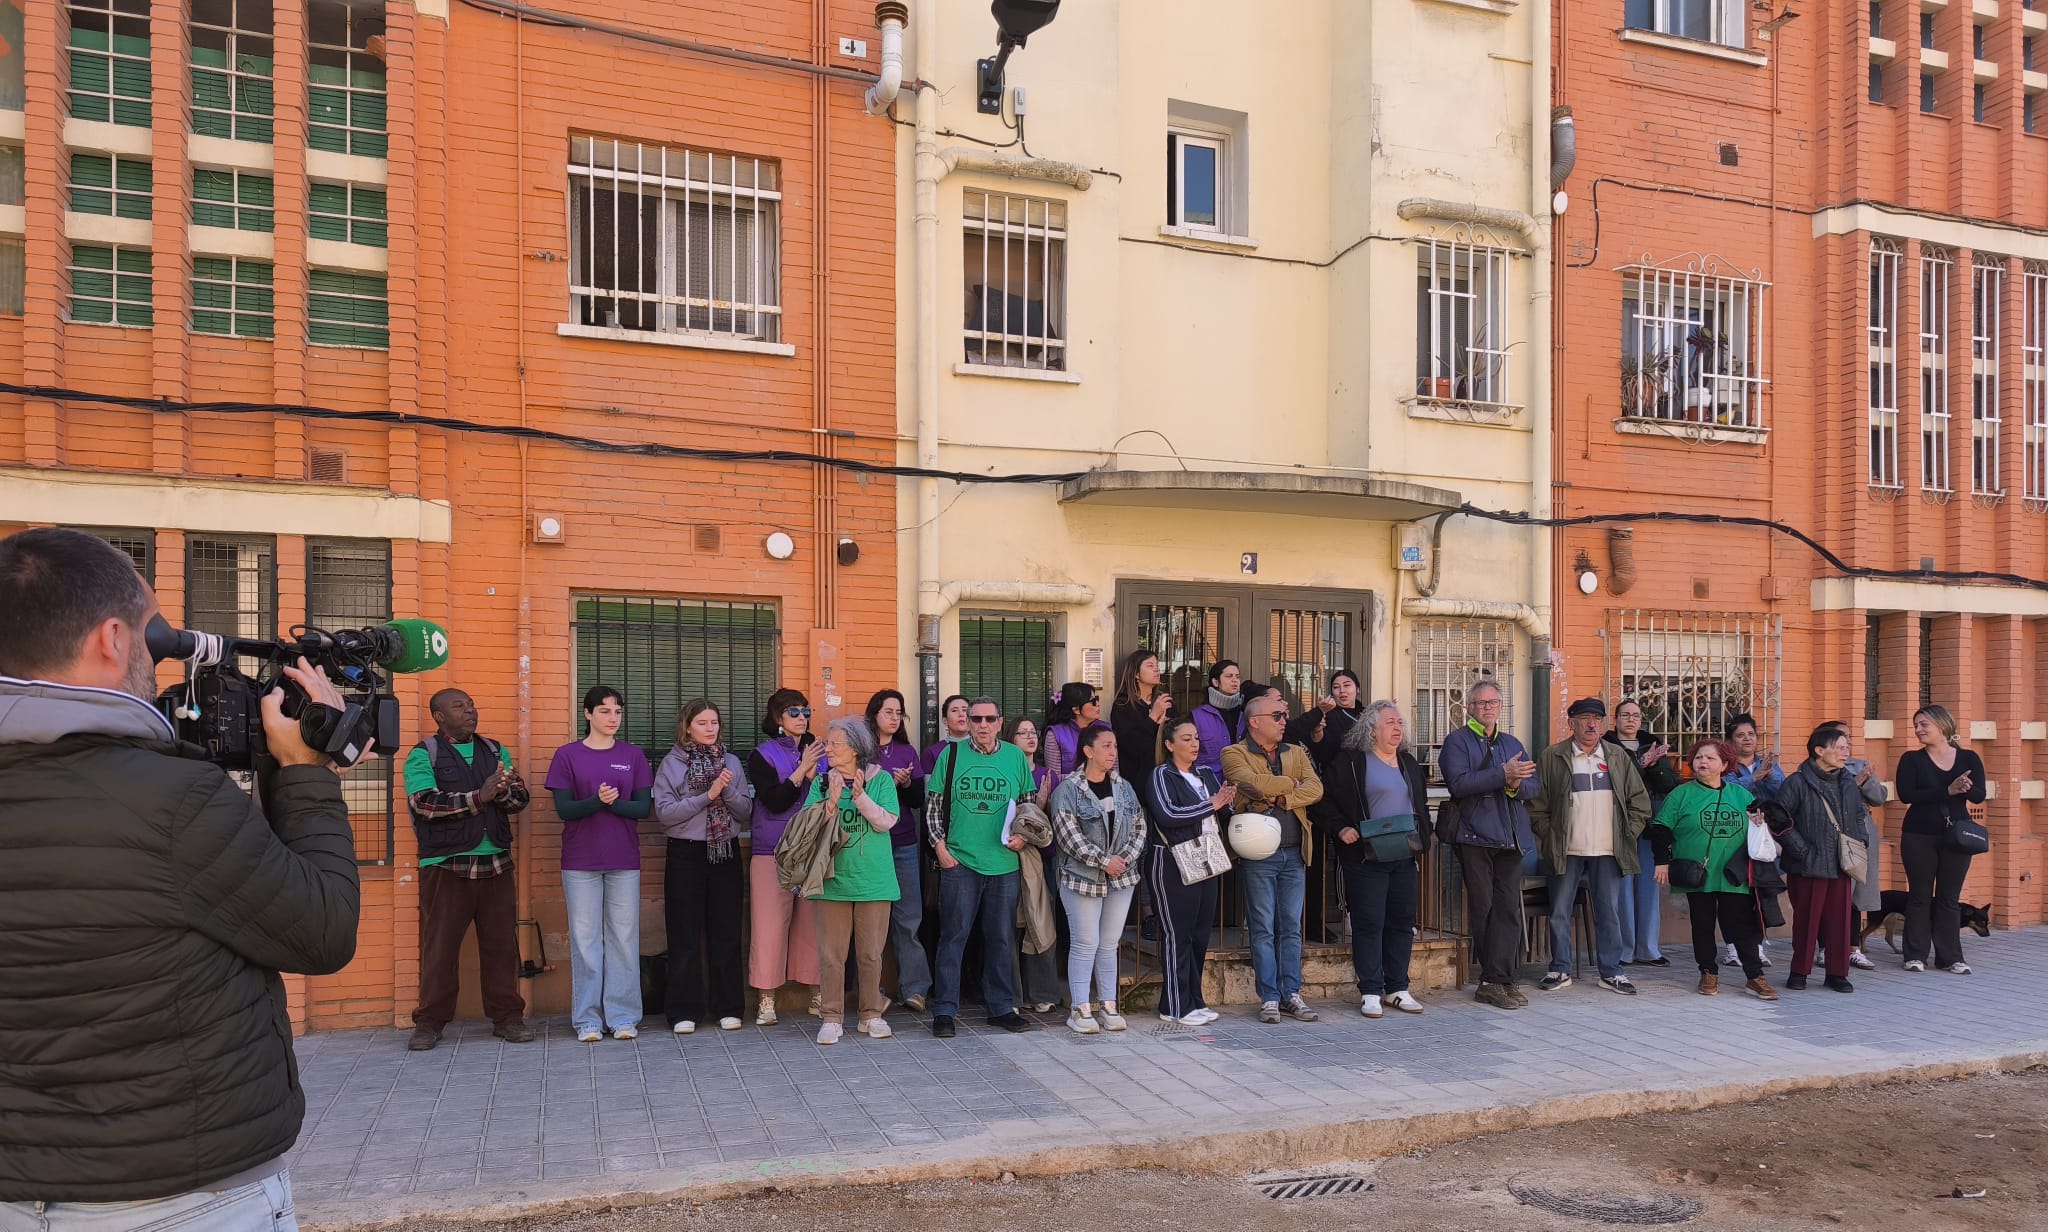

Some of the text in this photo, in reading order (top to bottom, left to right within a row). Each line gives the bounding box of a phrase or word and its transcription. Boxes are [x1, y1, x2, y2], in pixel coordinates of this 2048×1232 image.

[844, 40, 856, 54] 4
[1242, 554, 1253, 574] 2
[960, 776, 1007, 792] STOP
[960, 792, 1007, 802] DESNONAMENTS
[1703, 810, 1740, 821] STOP
[1703, 820, 1741, 828] DESONAMENTS
